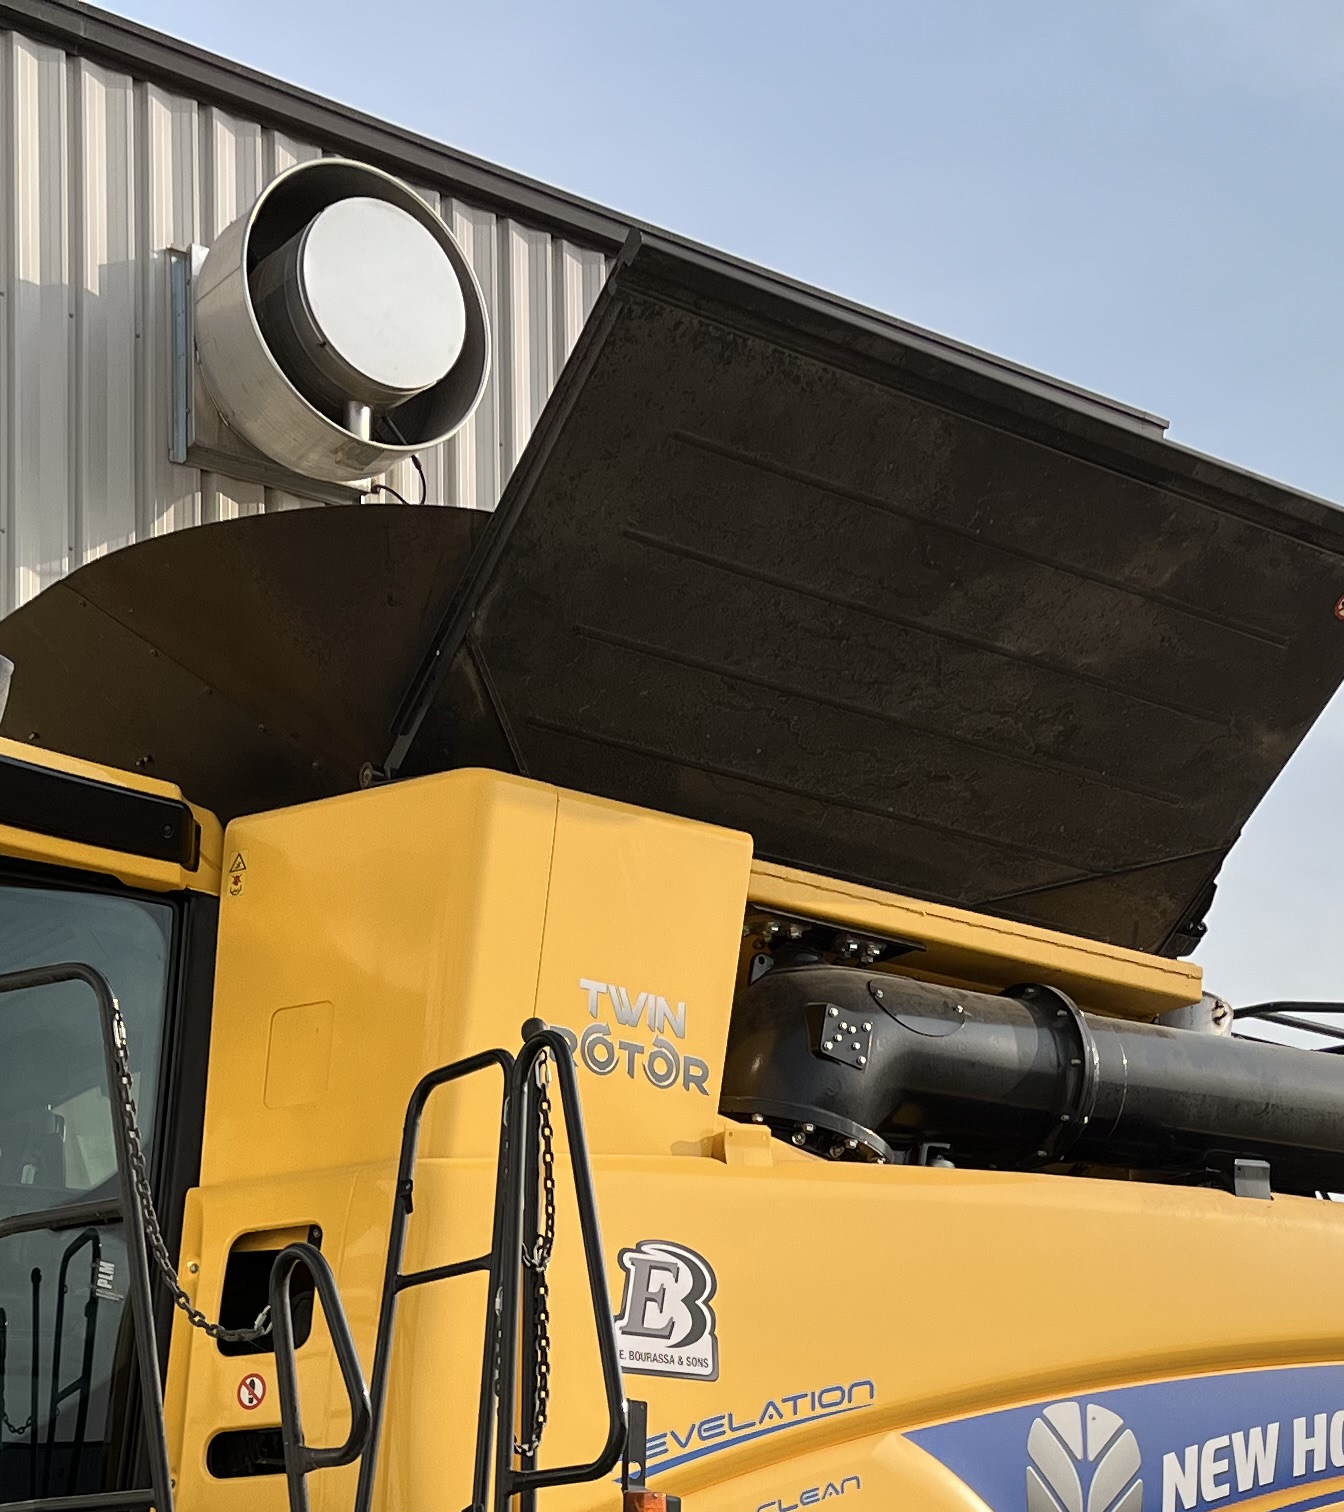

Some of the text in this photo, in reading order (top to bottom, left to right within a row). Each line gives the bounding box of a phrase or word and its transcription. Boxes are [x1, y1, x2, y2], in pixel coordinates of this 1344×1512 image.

[579, 978, 686, 1039] TWIN
[97, 1261, 115, 1290] PLM
[629, 1350, 675, 1366] BOURASSA
[677, 1356, 684, 1366] &
[686, 1356, 709, 1369] SONS
[619, 1379, 875, 1462] EVELATION
